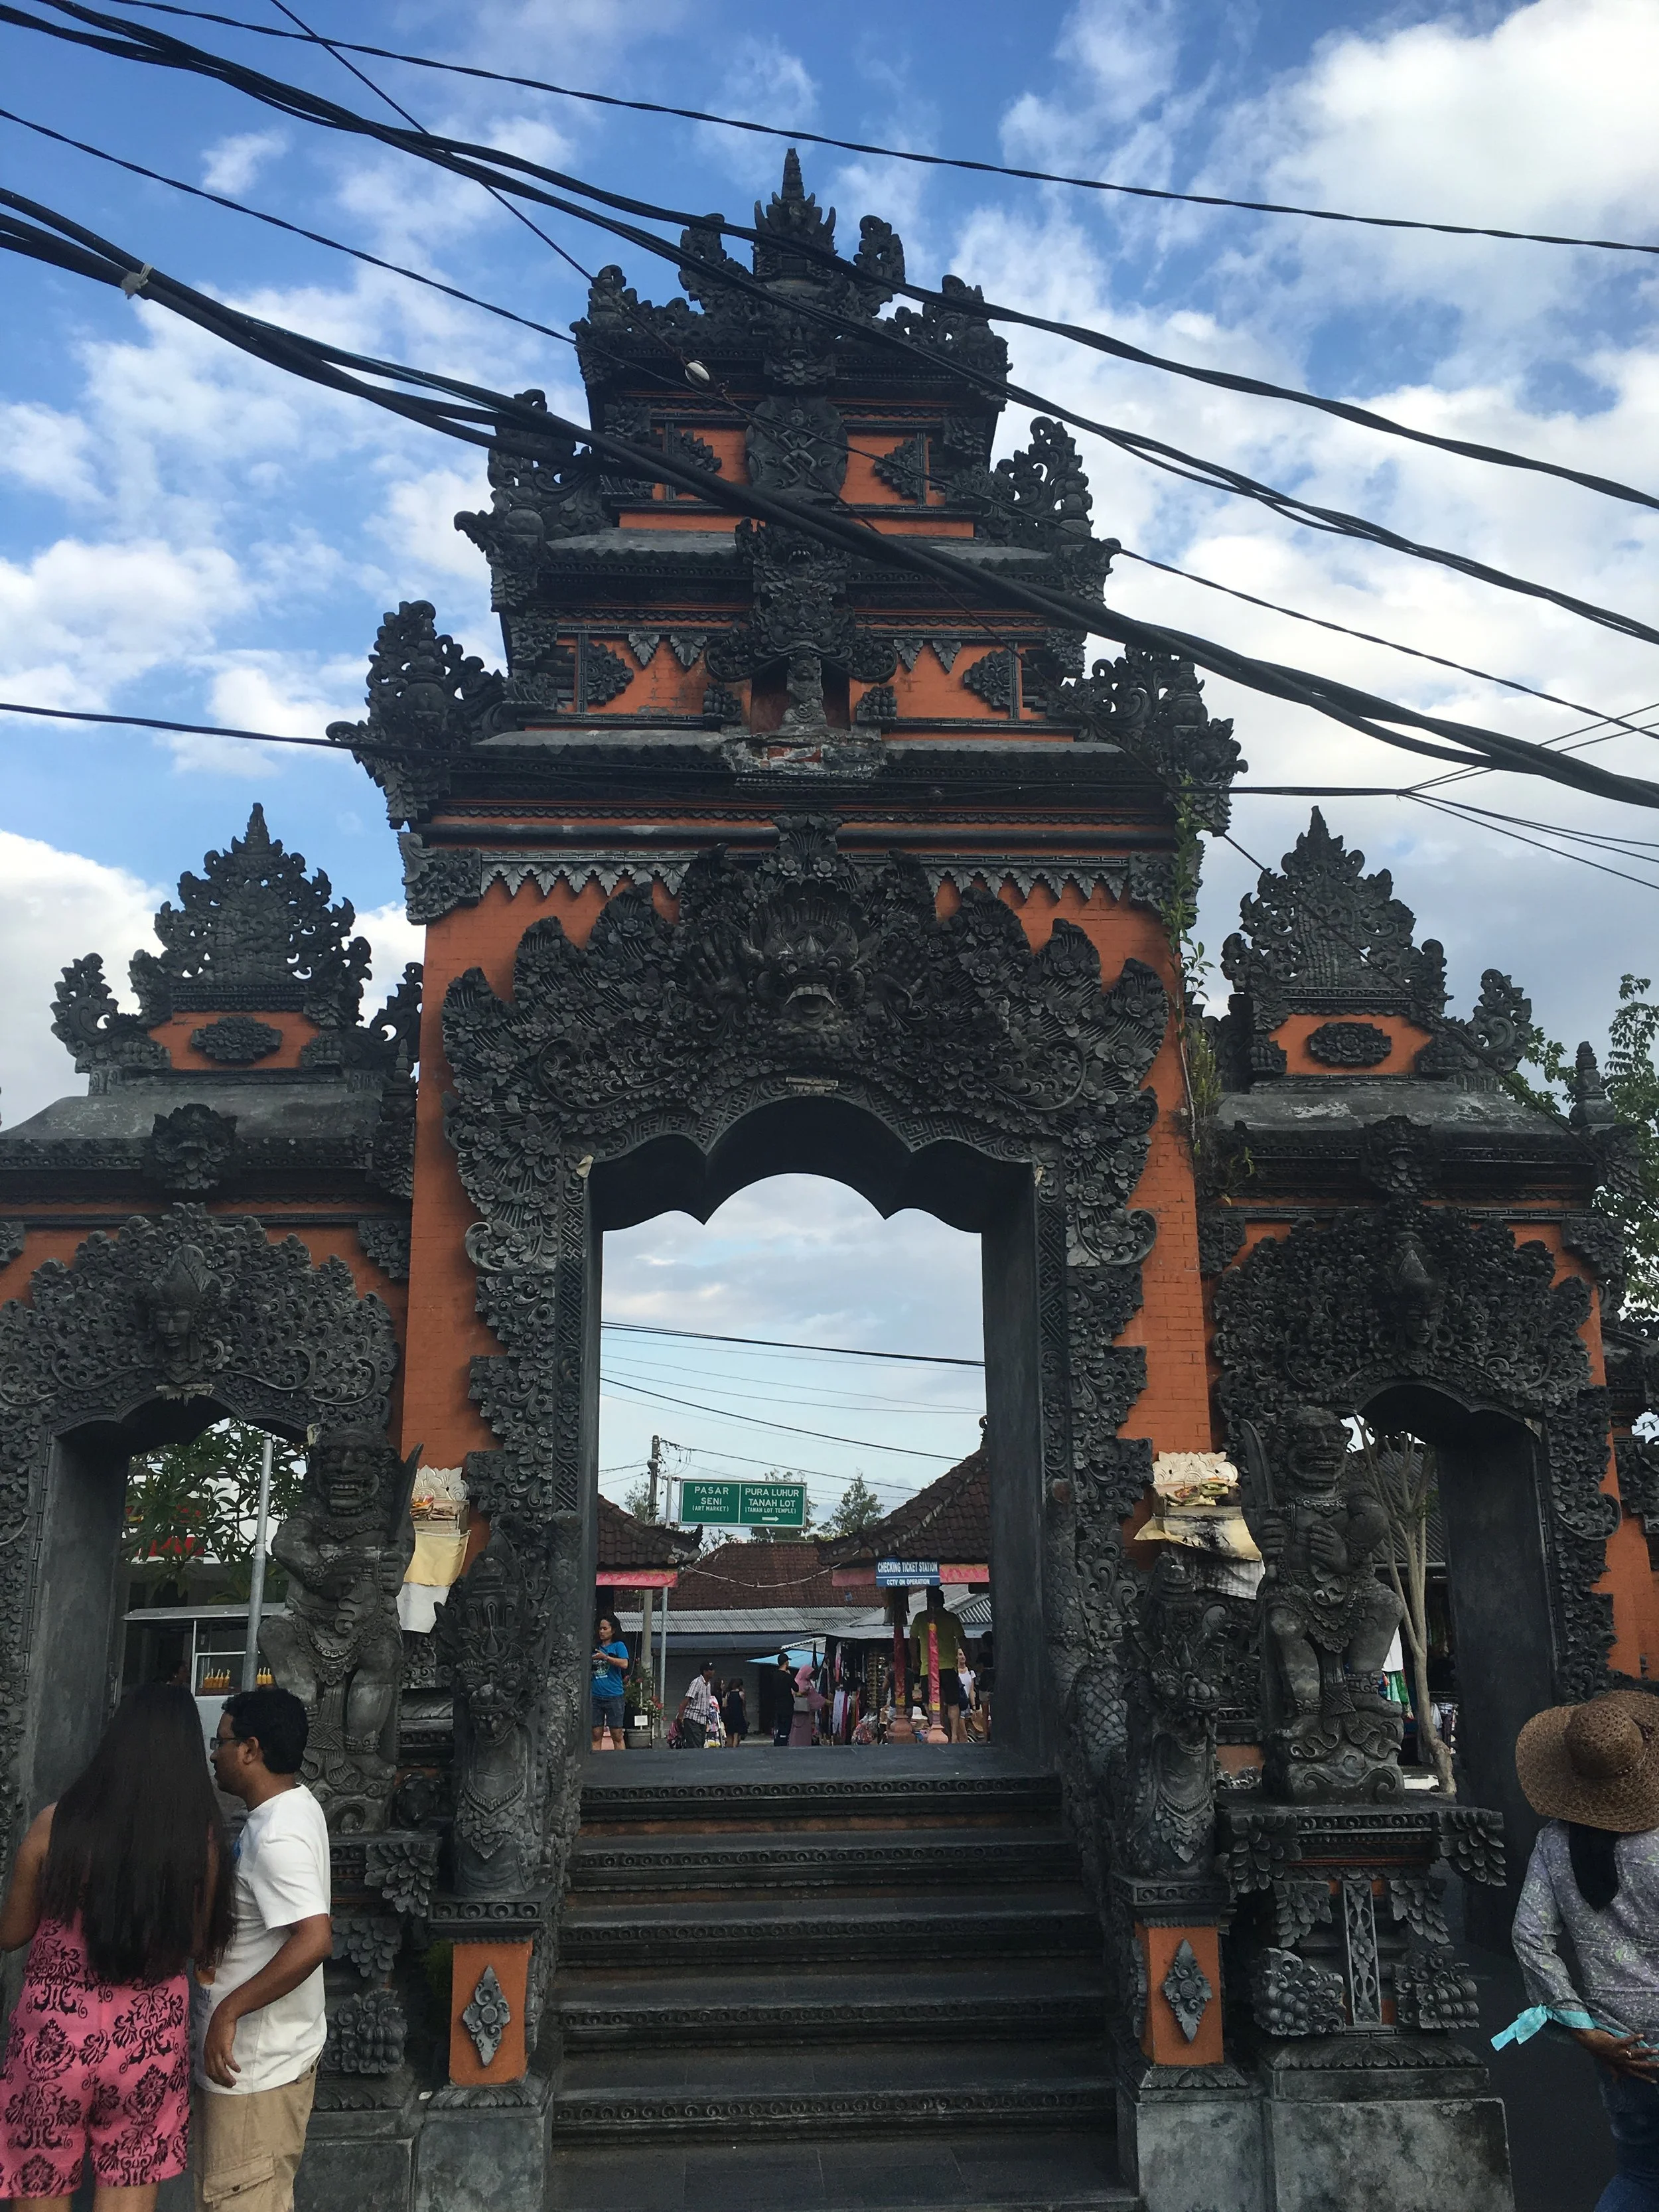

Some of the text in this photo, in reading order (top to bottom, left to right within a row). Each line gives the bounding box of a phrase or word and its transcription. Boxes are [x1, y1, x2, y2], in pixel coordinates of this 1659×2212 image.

[694, 1486, 729, 1495] PASAR
[700, 1497, 722, 1505] SENI
[748, 1498, 777, 1507] TANAH
[877, 1562, 938, 1573] CHECKING TICKET STATION
